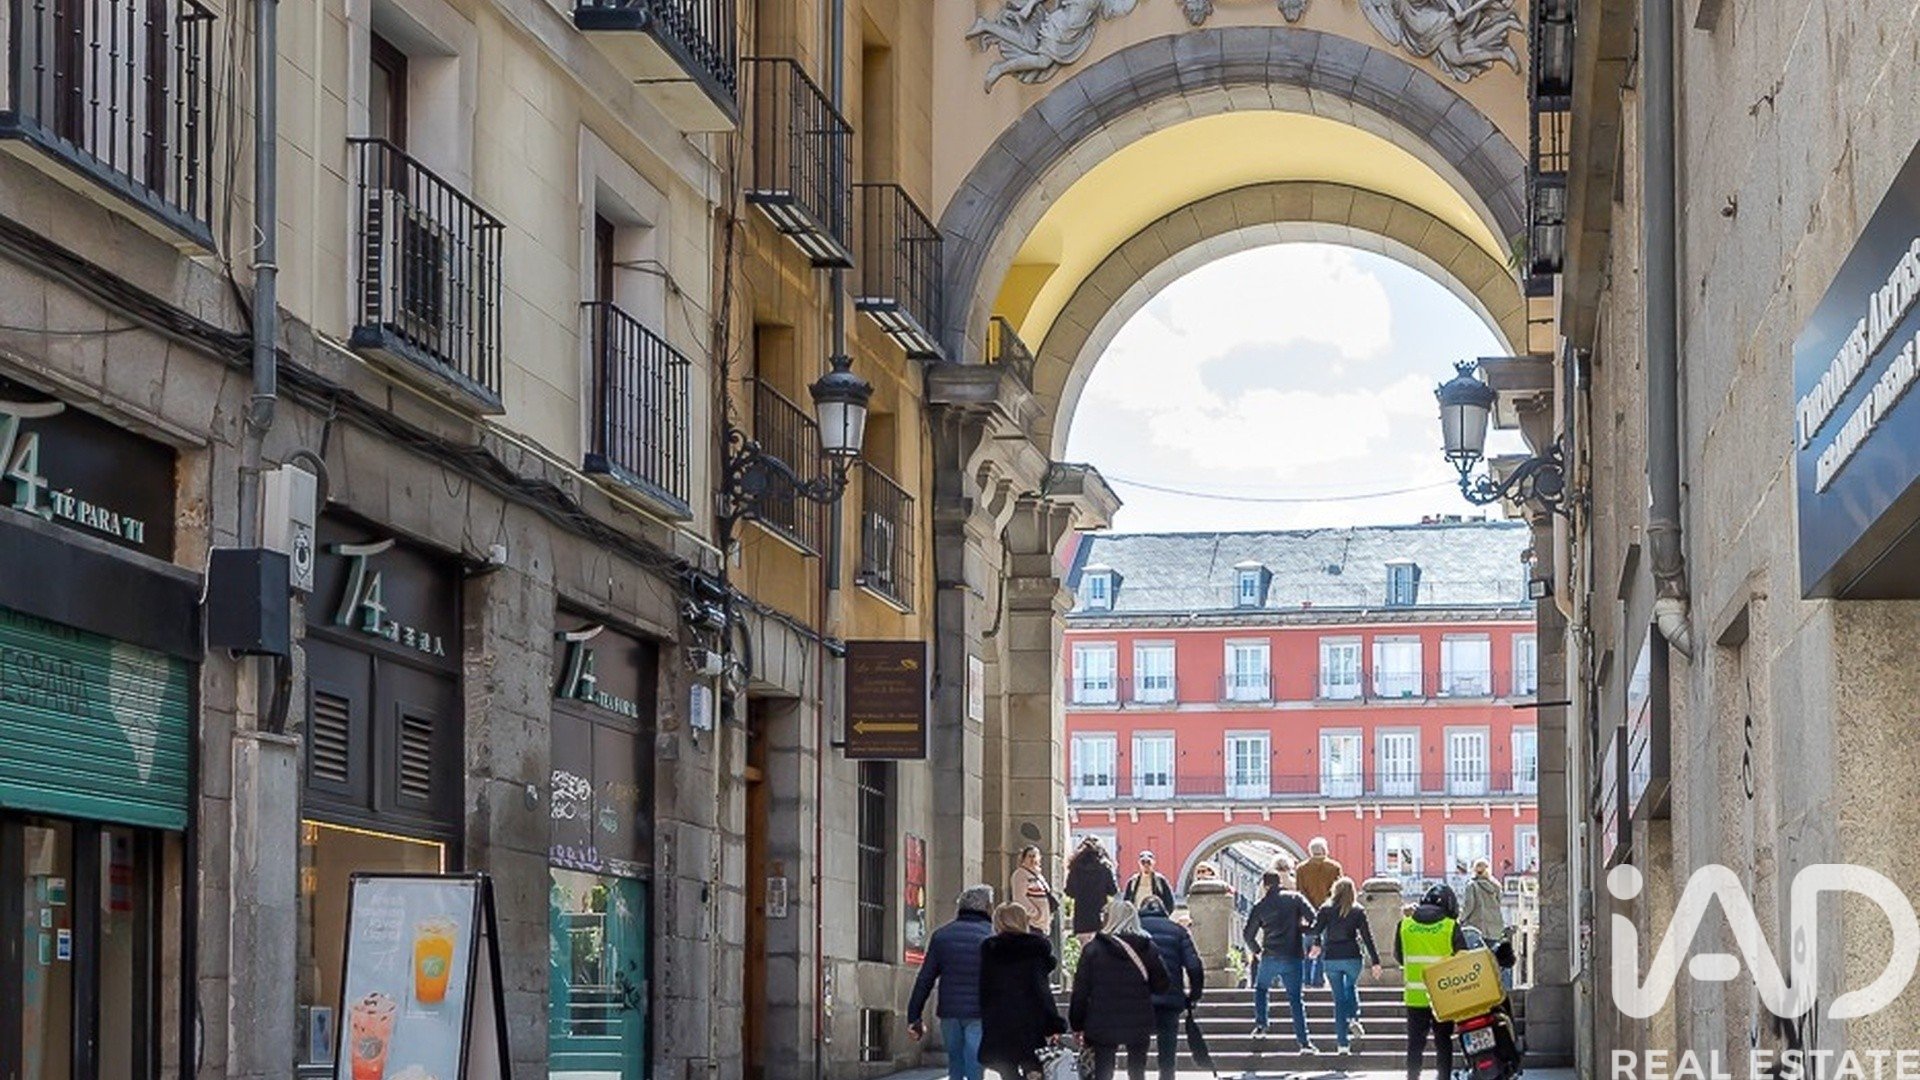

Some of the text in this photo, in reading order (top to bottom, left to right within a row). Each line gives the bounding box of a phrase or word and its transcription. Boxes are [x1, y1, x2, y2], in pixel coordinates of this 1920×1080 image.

[51, 488, 144, 543] TÉ PARA TI
[1437, 966, 1480, 990] Glovo
